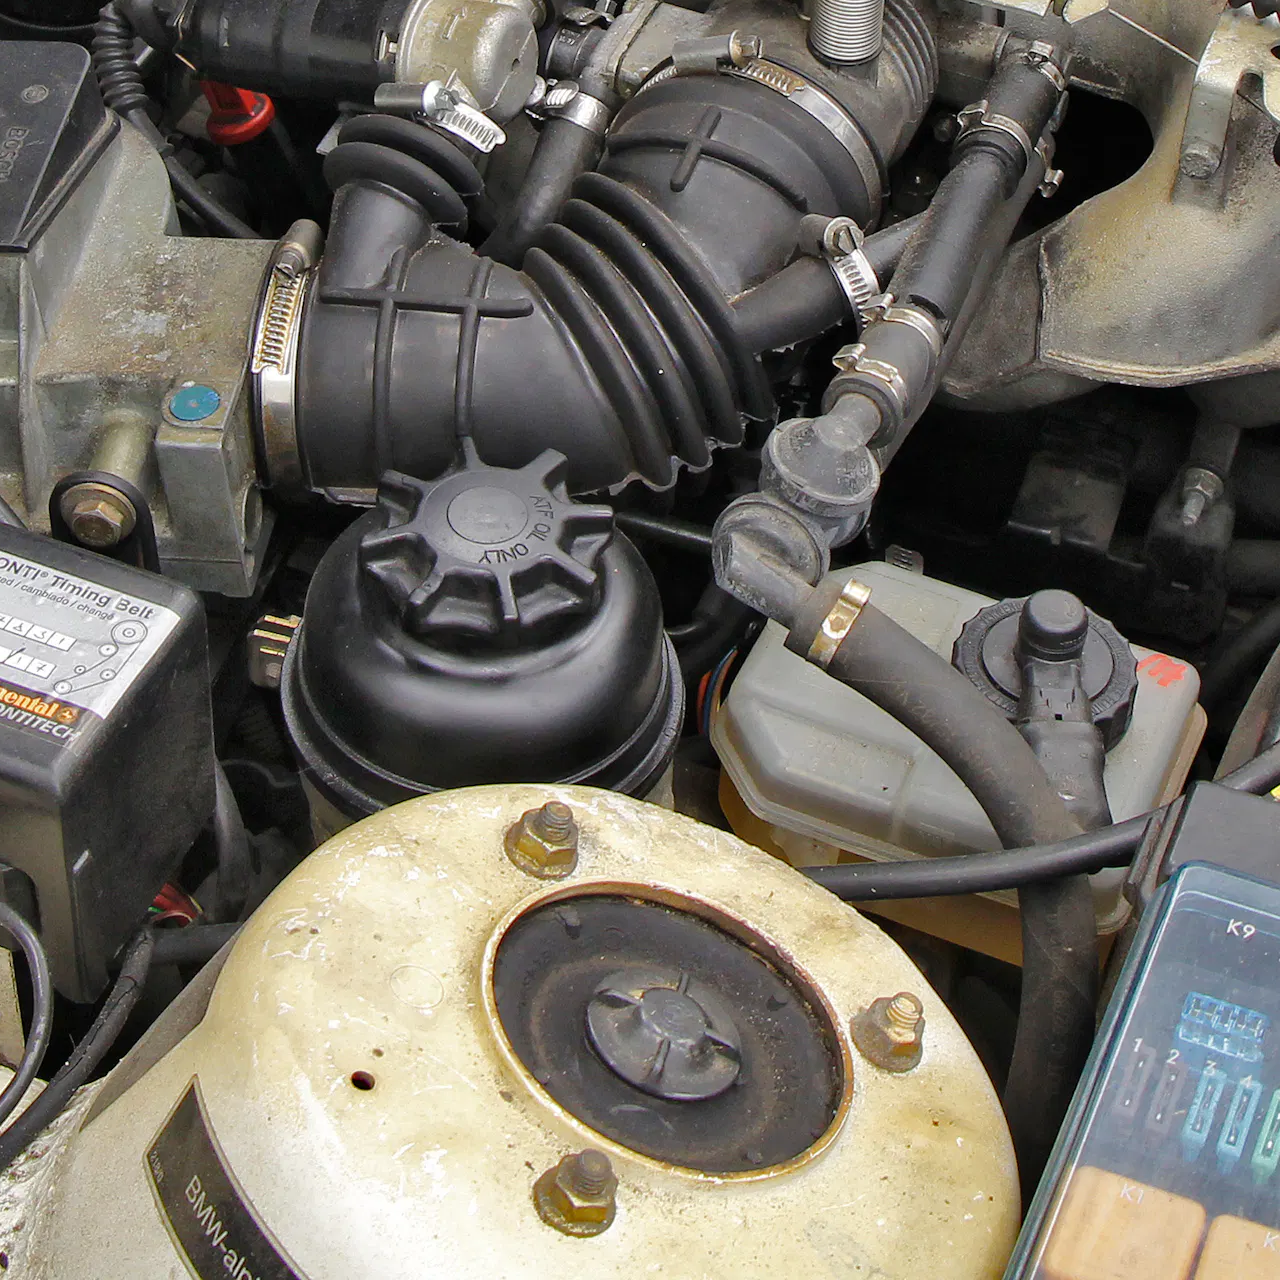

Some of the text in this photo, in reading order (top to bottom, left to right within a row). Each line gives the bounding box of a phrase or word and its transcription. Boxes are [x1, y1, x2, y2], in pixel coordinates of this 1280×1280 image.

[529, 494, 554, 519] ATF
[525, 523, 551, 542] OIL
[478, 543, 529, 564] ONLY
[21, 583, 70, 606] cambiado
[51, 575, 112, 607] Timing
[115, 597, 155, 619] Belt
[1226, 918, 1256, 939] K9
[1133, 1037, 1144, 1053] 1
[1166, 1048, 1181, 1065] 2
[1204, 1059, 1218, 1076] 3
[1120, 1183, 1145, 1205] K1
[184, 1174, 271, 1280] BMW-alp
